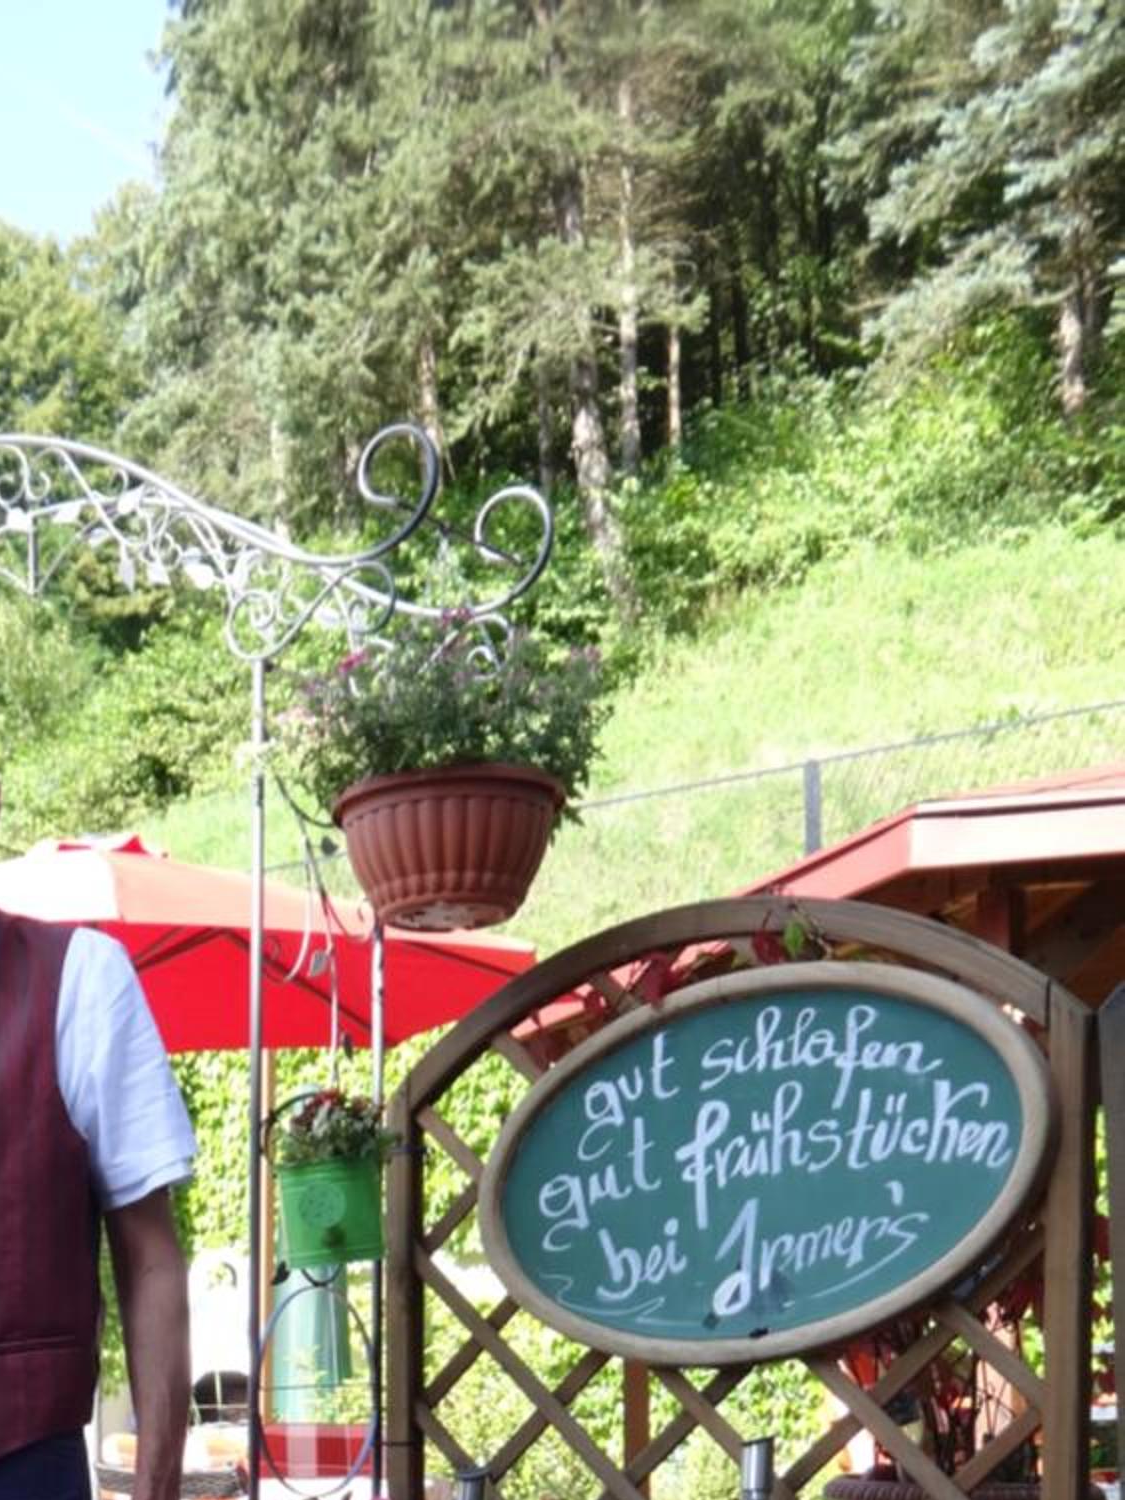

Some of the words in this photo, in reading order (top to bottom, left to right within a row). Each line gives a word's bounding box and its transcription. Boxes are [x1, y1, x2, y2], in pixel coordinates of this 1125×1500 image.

[577, 1031, 679, 1162] gut
[699, 1004, 944, 1111] schlafen
[538, 1116, 662, 1251] gut
[596, 1217, 689, 1299] bei
